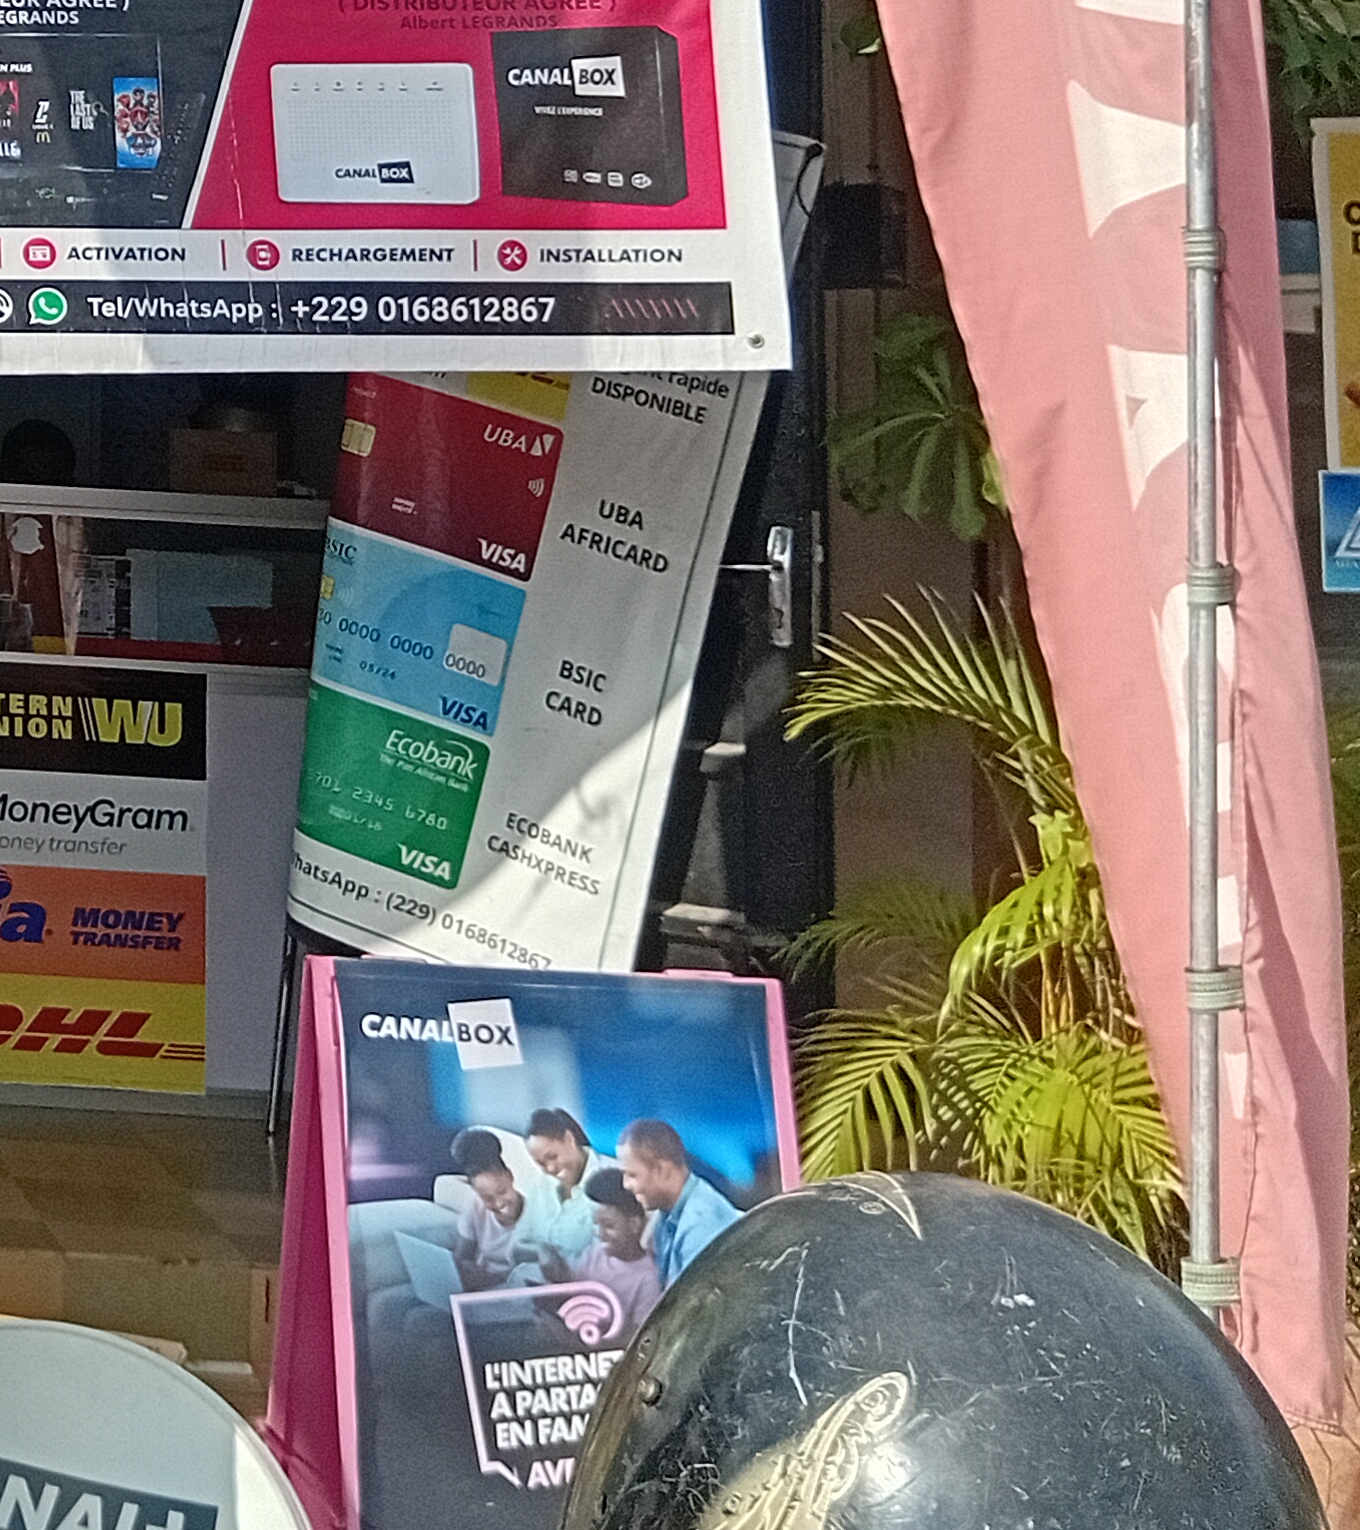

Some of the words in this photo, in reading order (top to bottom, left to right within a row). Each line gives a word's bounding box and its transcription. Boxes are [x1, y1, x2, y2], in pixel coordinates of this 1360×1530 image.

[400, 14, 455, 30] Albert
[460, 14, 559, 30] LEGRANDS
[66, 247, 186, 262] ACTIVATION
[290, 247, 455, 264] RECHARGEMENT
[538, 248, 684, 264] INSTALLATION
[87, 296, 263, 321] Tel/WhatsApp
[290, 298, 368, 324] +229
[377, 297, 556, 324] 0168612867
[590, 375, 707, 425] DISPONIBLE
[482, 423, 529, 454] UBA
[597, 498, 645, 532] UBA
[477, 536, 528, 575] VISA
[558, 521, 670, 575] AFRICARD
[558, 658, 608, 694] BSIC
[91, 697, 183, 748] WU
[438, 695, 490, 731] VISA
[543, 690, 605, 728] CARD
[383, 727, 481, 781] Ecobank
[48, 836, 128, 857] transfer
[504, 811, 594, 866] ECOBANK
[396, 842, 452, 882] VISA
[486, 833, 601, 897] CASHXPRESS
[71, 905, 186, 934] MONEY
[385, 891, 438, 929] (229)
[69, 929, 182, 953] TRANSFER
[515, 1382, 602, 1418] PARTA
[495, 1418, 534, 1450] EN
